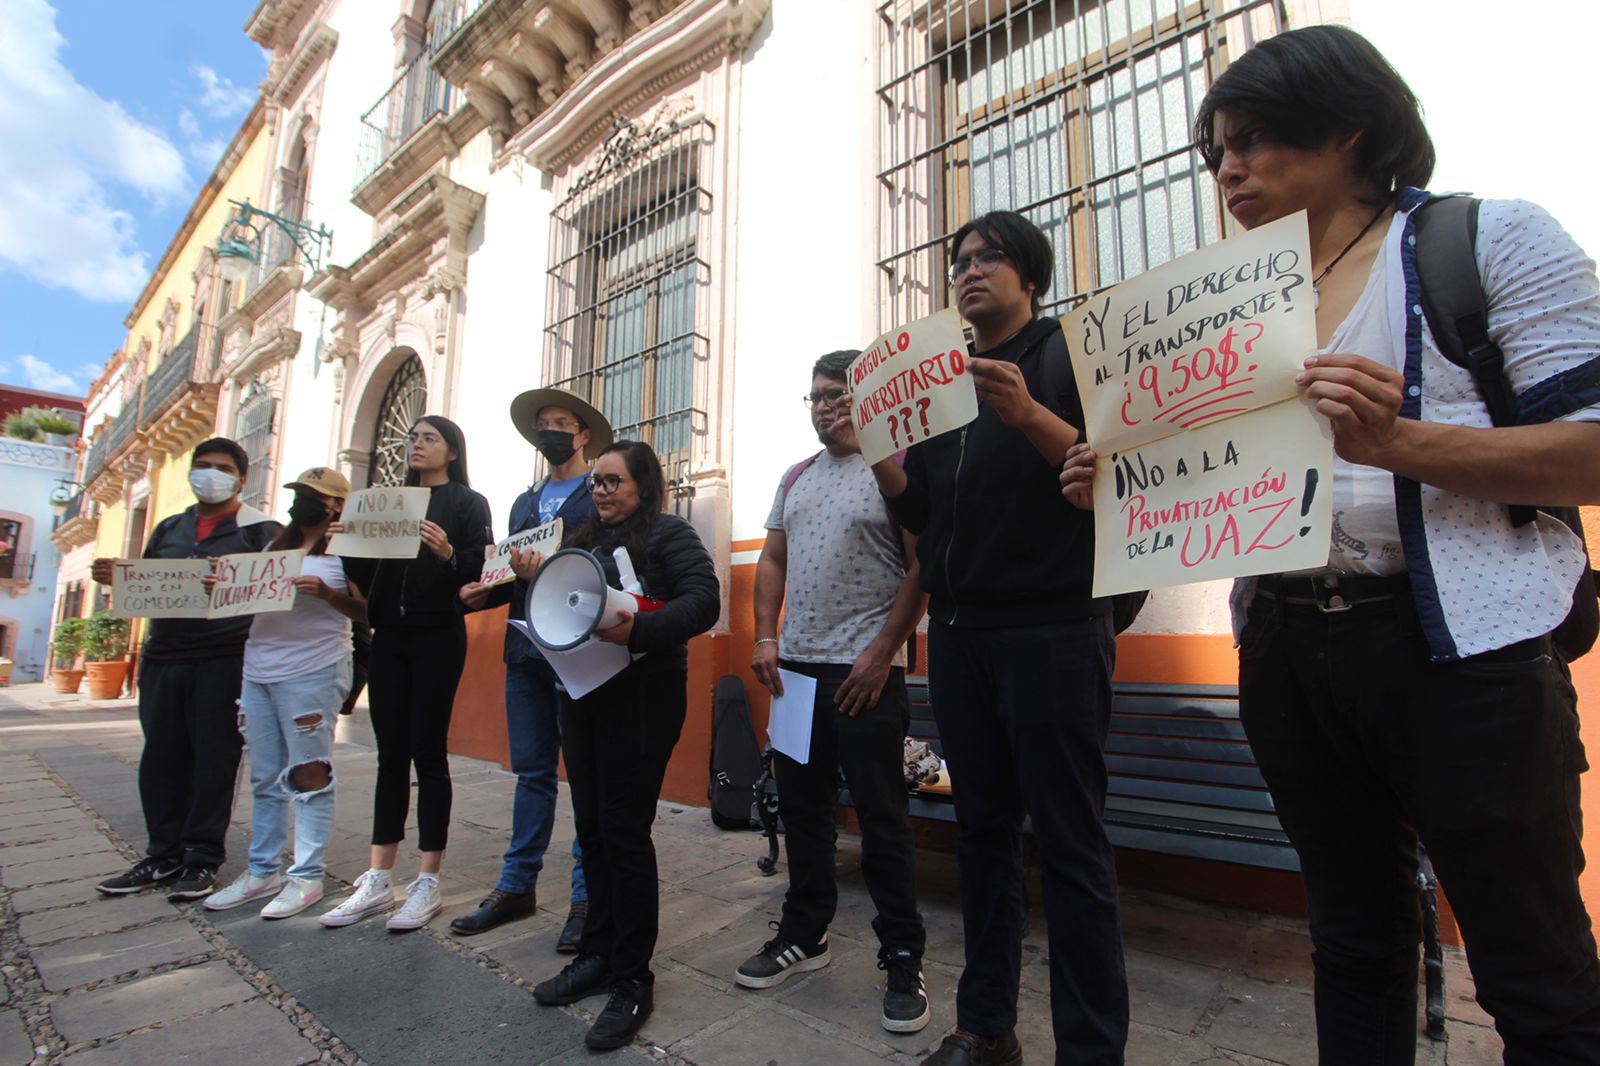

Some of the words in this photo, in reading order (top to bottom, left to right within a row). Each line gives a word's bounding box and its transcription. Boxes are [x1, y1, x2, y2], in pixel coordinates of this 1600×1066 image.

[1083, 296, 1111, 355] ¿Y
[1122, 301, 1158, 340] EL
[1166, 249, 1299, 317] DERECHO
[1095, 364, 1113, 386] AL
[1117, 274, 1304, 375] TRANSPORTE?
[856, 349, 965, 431] UNIVERSITARIO
[1121, 322, 1264, 427] ¿9.50$?
[887, 397, 931, 449] ???
[1112, 452, 1165, 500] ¡NO
[1176, 457, 1188, 477] A
[1203, 440, 1240, 472] LA
[393, 494, 404, 511] A
[498, 523, 556, 557] COMEDORES
[1126, 538, 1148, 560] DE
[1152, 531, 1174, 553] LA
[127, 584, 152, 593] CIA
[161, 583, 182, 593] EN
[249, 556, 286, 582] LAS
[124, 595, 209, 611] COMEDORES
